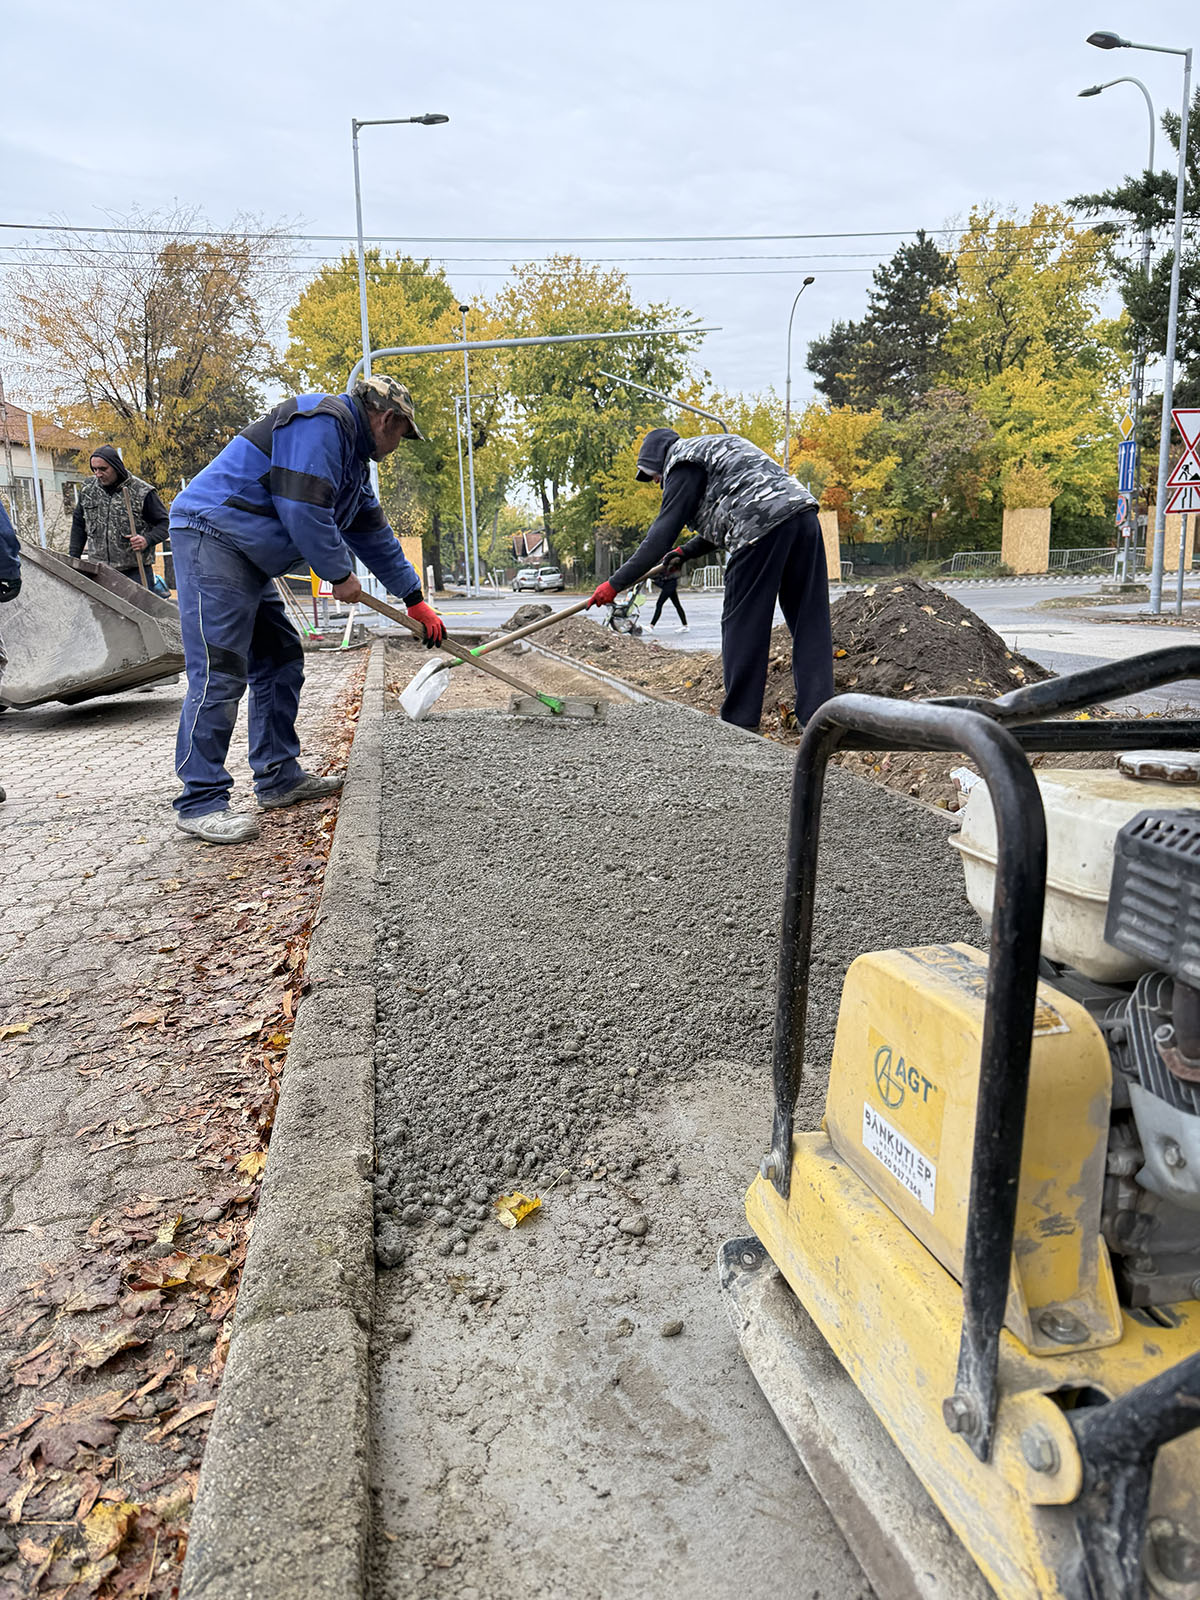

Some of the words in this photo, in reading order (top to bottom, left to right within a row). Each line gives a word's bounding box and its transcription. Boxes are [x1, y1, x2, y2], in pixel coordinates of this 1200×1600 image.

[895, 1056, 932, 1102] AGT
[865, 1109, 915, 1169] BÁNKUTI
[884, 1155, 892, 1168] 20
